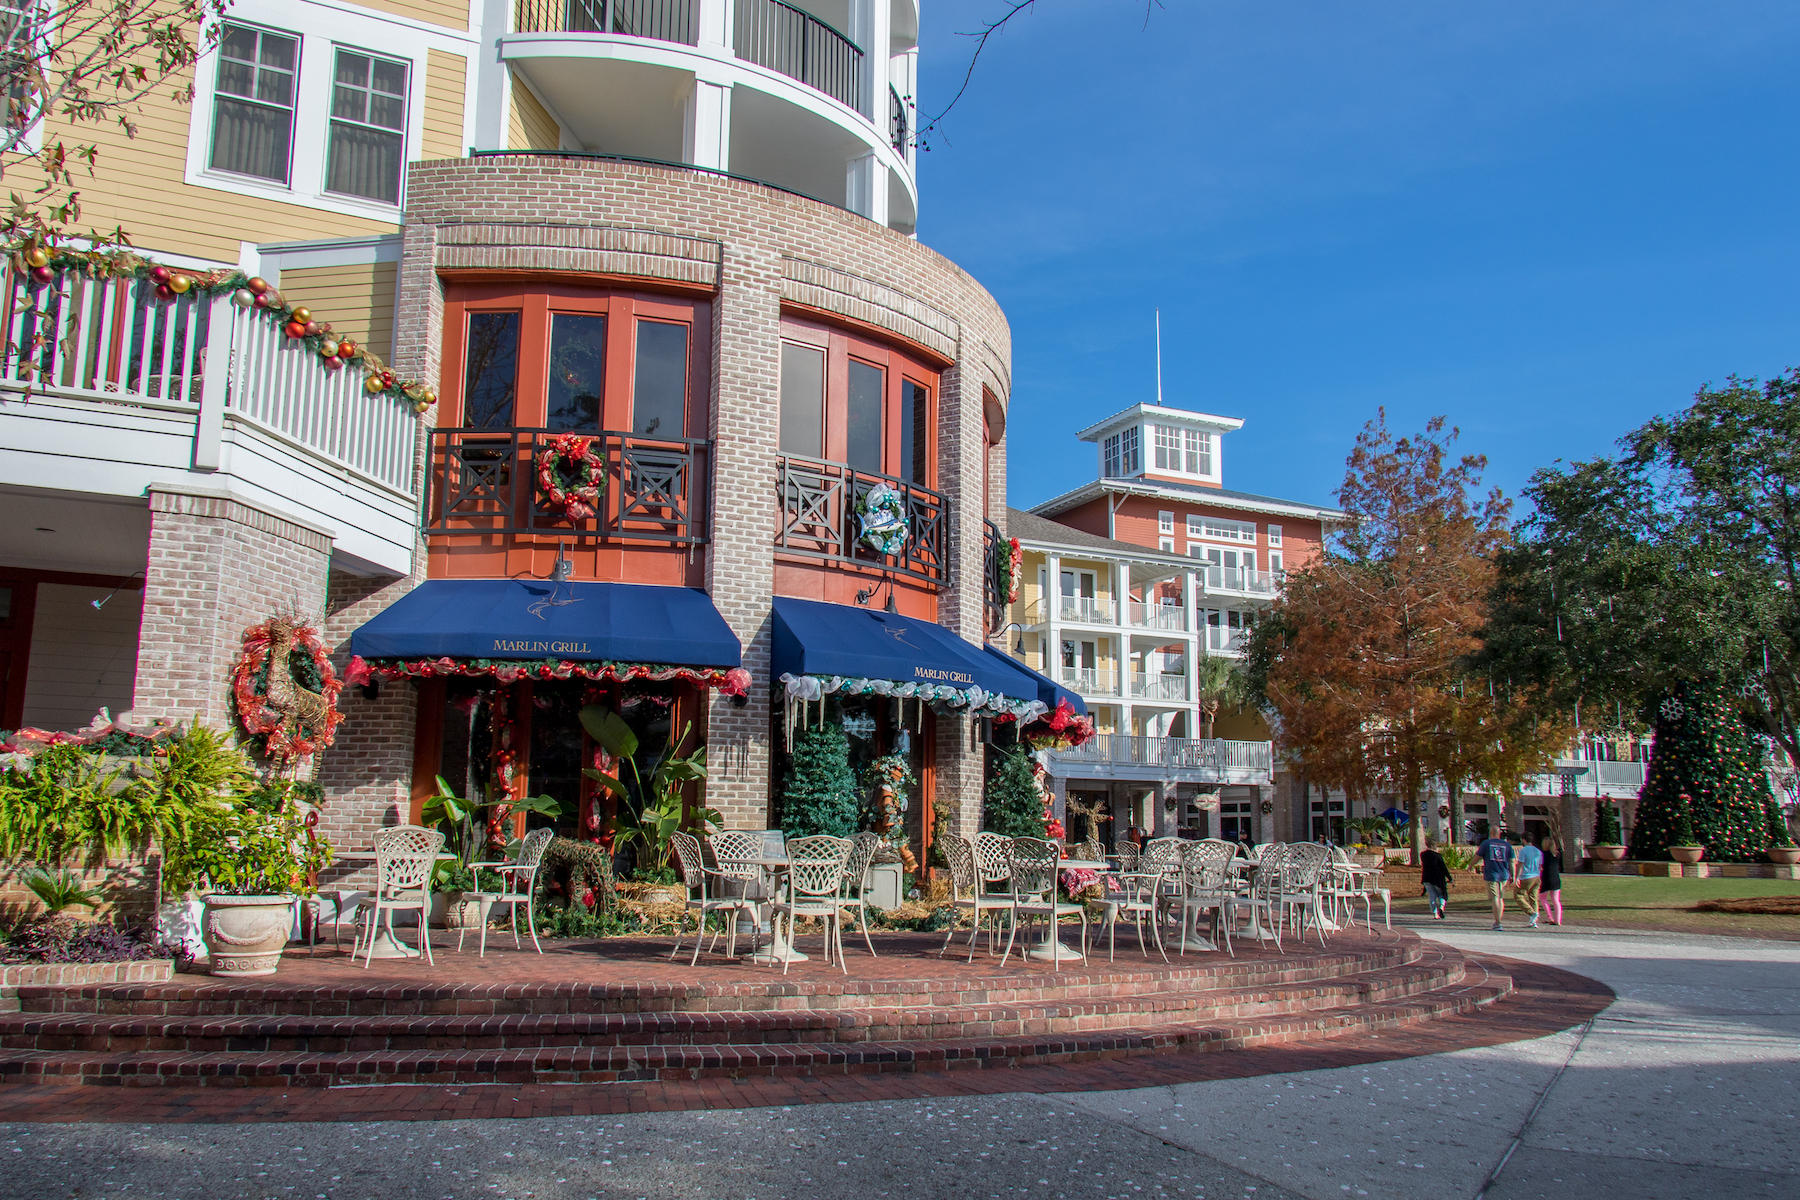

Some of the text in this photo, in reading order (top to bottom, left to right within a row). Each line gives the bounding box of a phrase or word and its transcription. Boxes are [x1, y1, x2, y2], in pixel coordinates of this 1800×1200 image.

[493, 639, 591, 653] MARLIN GRILL
[914, 666, 974, 684] MARLIN GRILL
